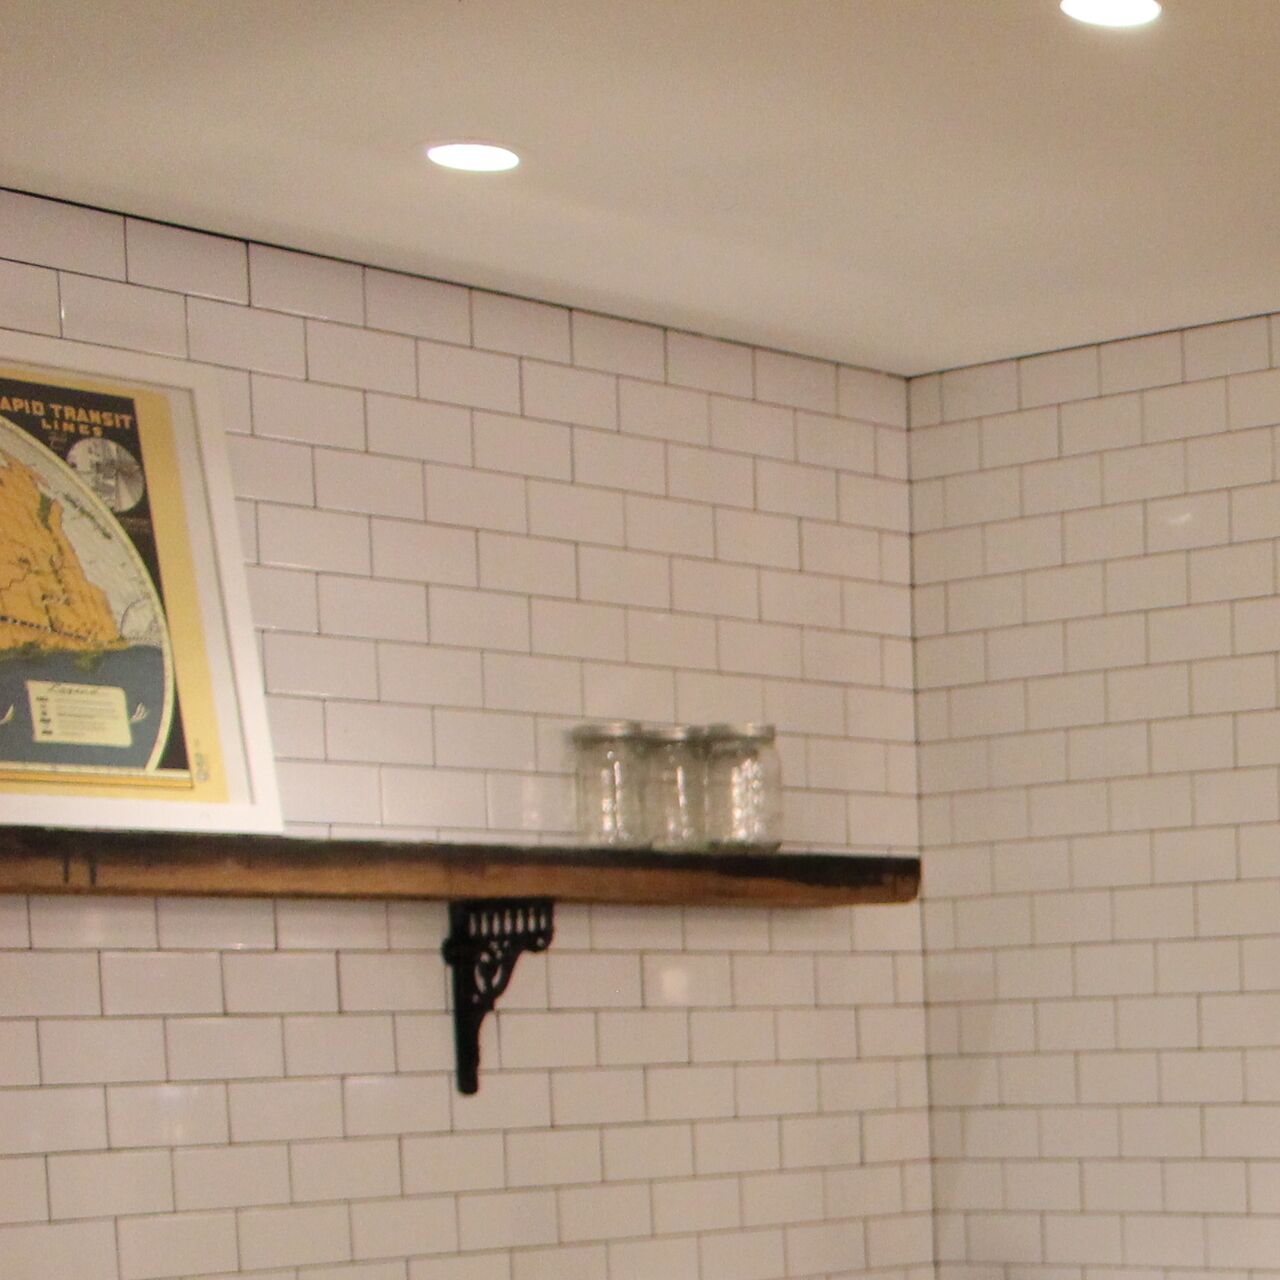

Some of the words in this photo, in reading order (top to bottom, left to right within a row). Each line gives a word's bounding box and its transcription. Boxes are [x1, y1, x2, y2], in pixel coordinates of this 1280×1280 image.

[0, 396, 45, 417] APID
[48, 402, 133, 430] TRANSIT
[41, 418, 104, 438] LINES
